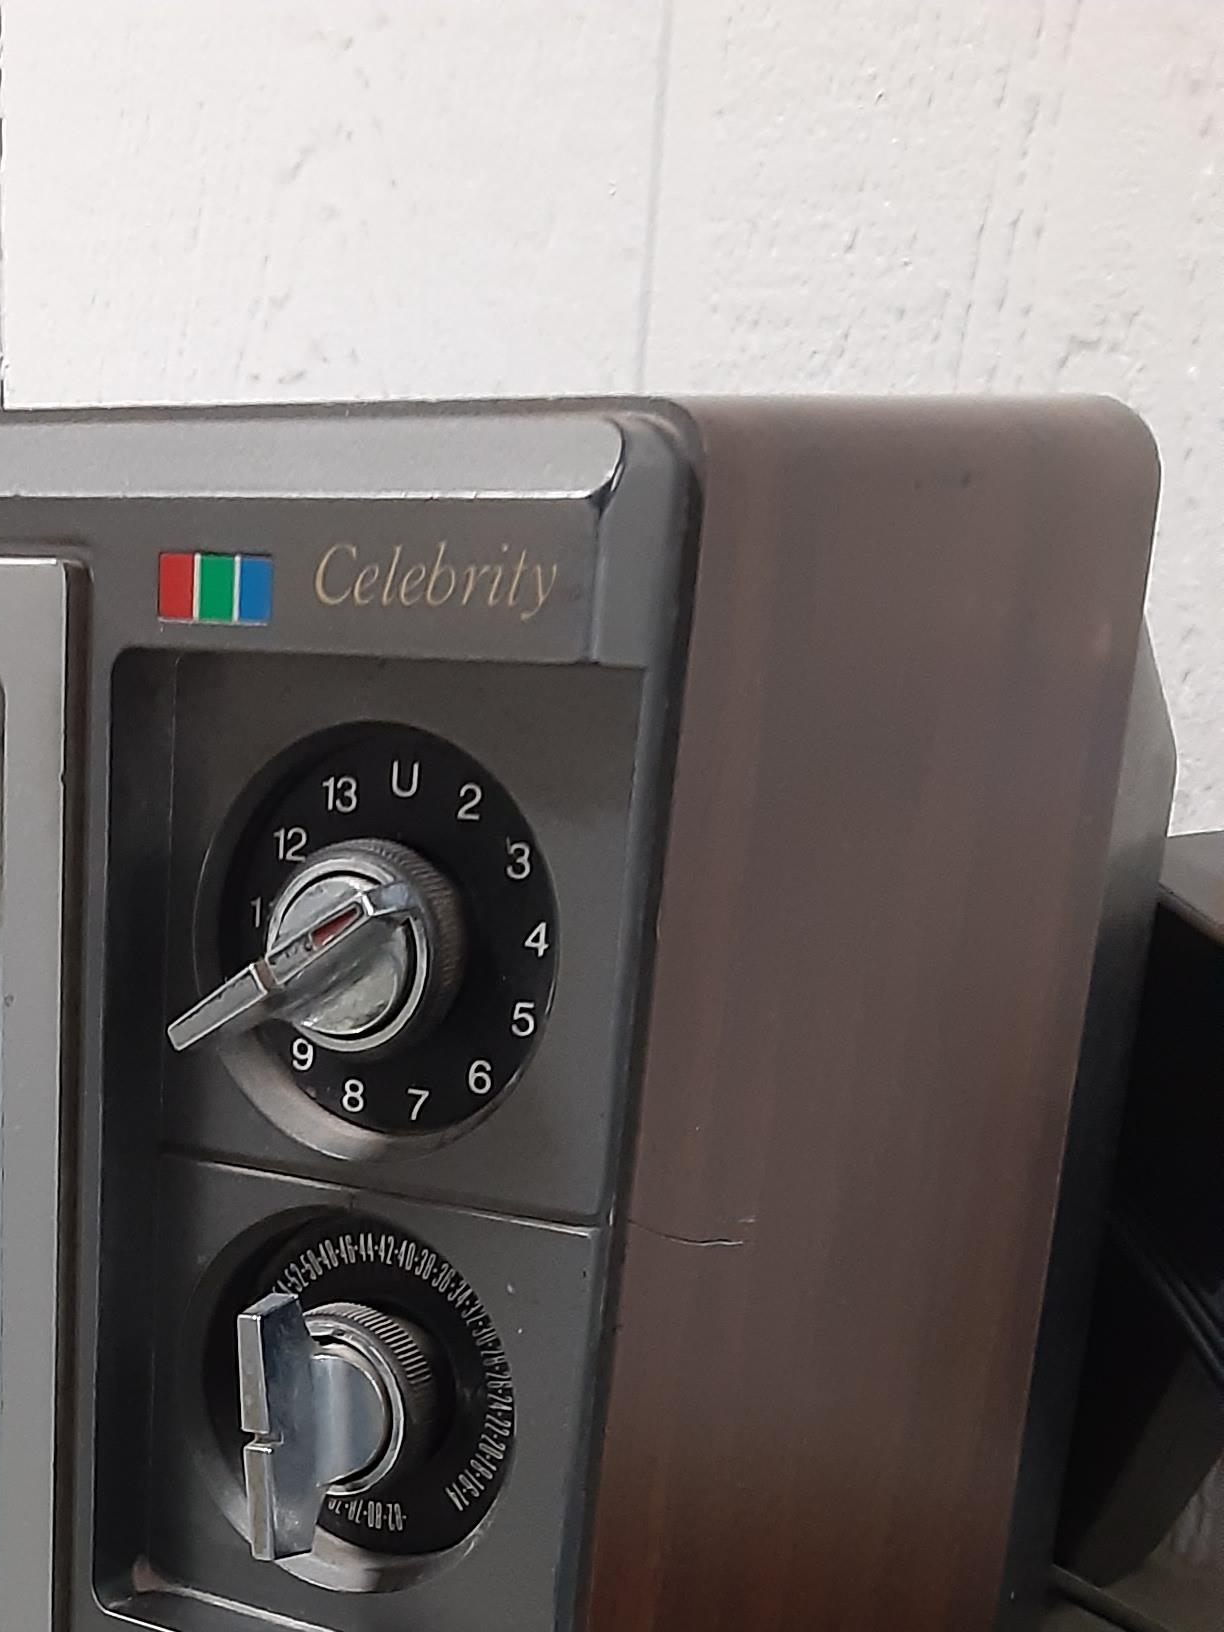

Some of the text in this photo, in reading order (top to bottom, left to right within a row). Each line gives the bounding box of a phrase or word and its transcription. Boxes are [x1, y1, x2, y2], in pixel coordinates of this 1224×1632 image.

[314, 540, 558, 620] Celebrity
[321, 775, 358, 813] 13
[391, 759, 420, 798] U
[457, 782, 483, 820] 2
[274, 826, 308, 863] 12
[506, 841, 532, 880] 3
[524, 921, 550, 957] 4
[511, 1001, 536, 1037] 5
[291, 1037, 315, 1071] 9
[341, 1078, 365, 1112] 8
[468, 1059, 493, 1095] 6
[406, 1088, 430, 1121] 7
[339, 1234, 356, 1265] 46
[359, 1233, 375, 1262] 44
[378, 1234, 395, 1265] 42
[398, 1240, 416, 1271] 40
